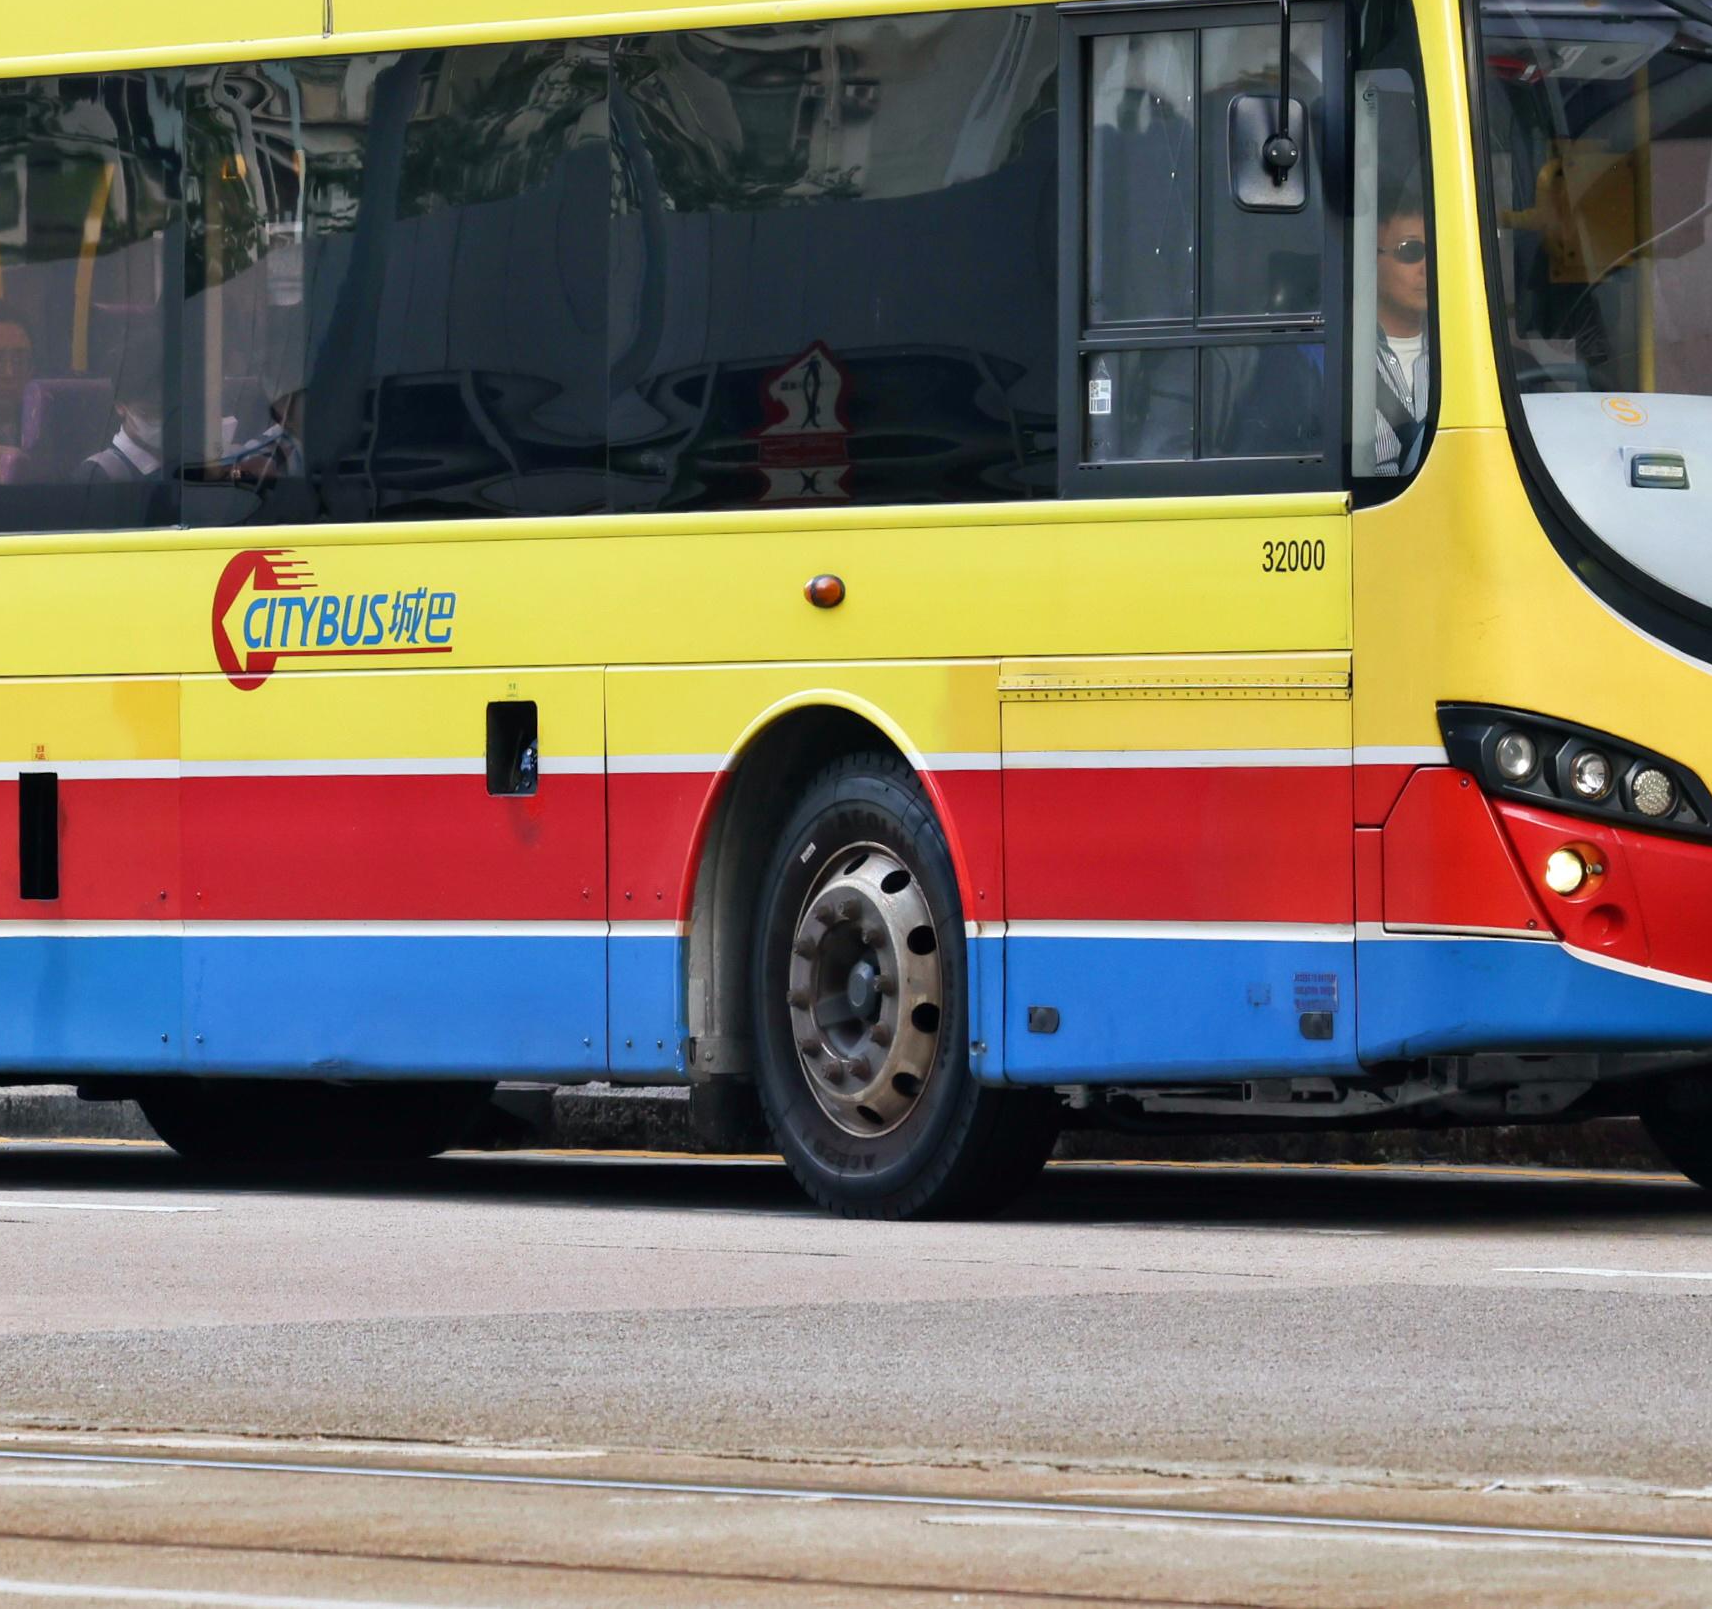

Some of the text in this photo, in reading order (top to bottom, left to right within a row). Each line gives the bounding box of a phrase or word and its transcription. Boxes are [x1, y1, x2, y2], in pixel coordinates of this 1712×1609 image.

[1262, 539, 1325, 572] 32000
[243, 587, 456, 649] CITYBUS 城巴
